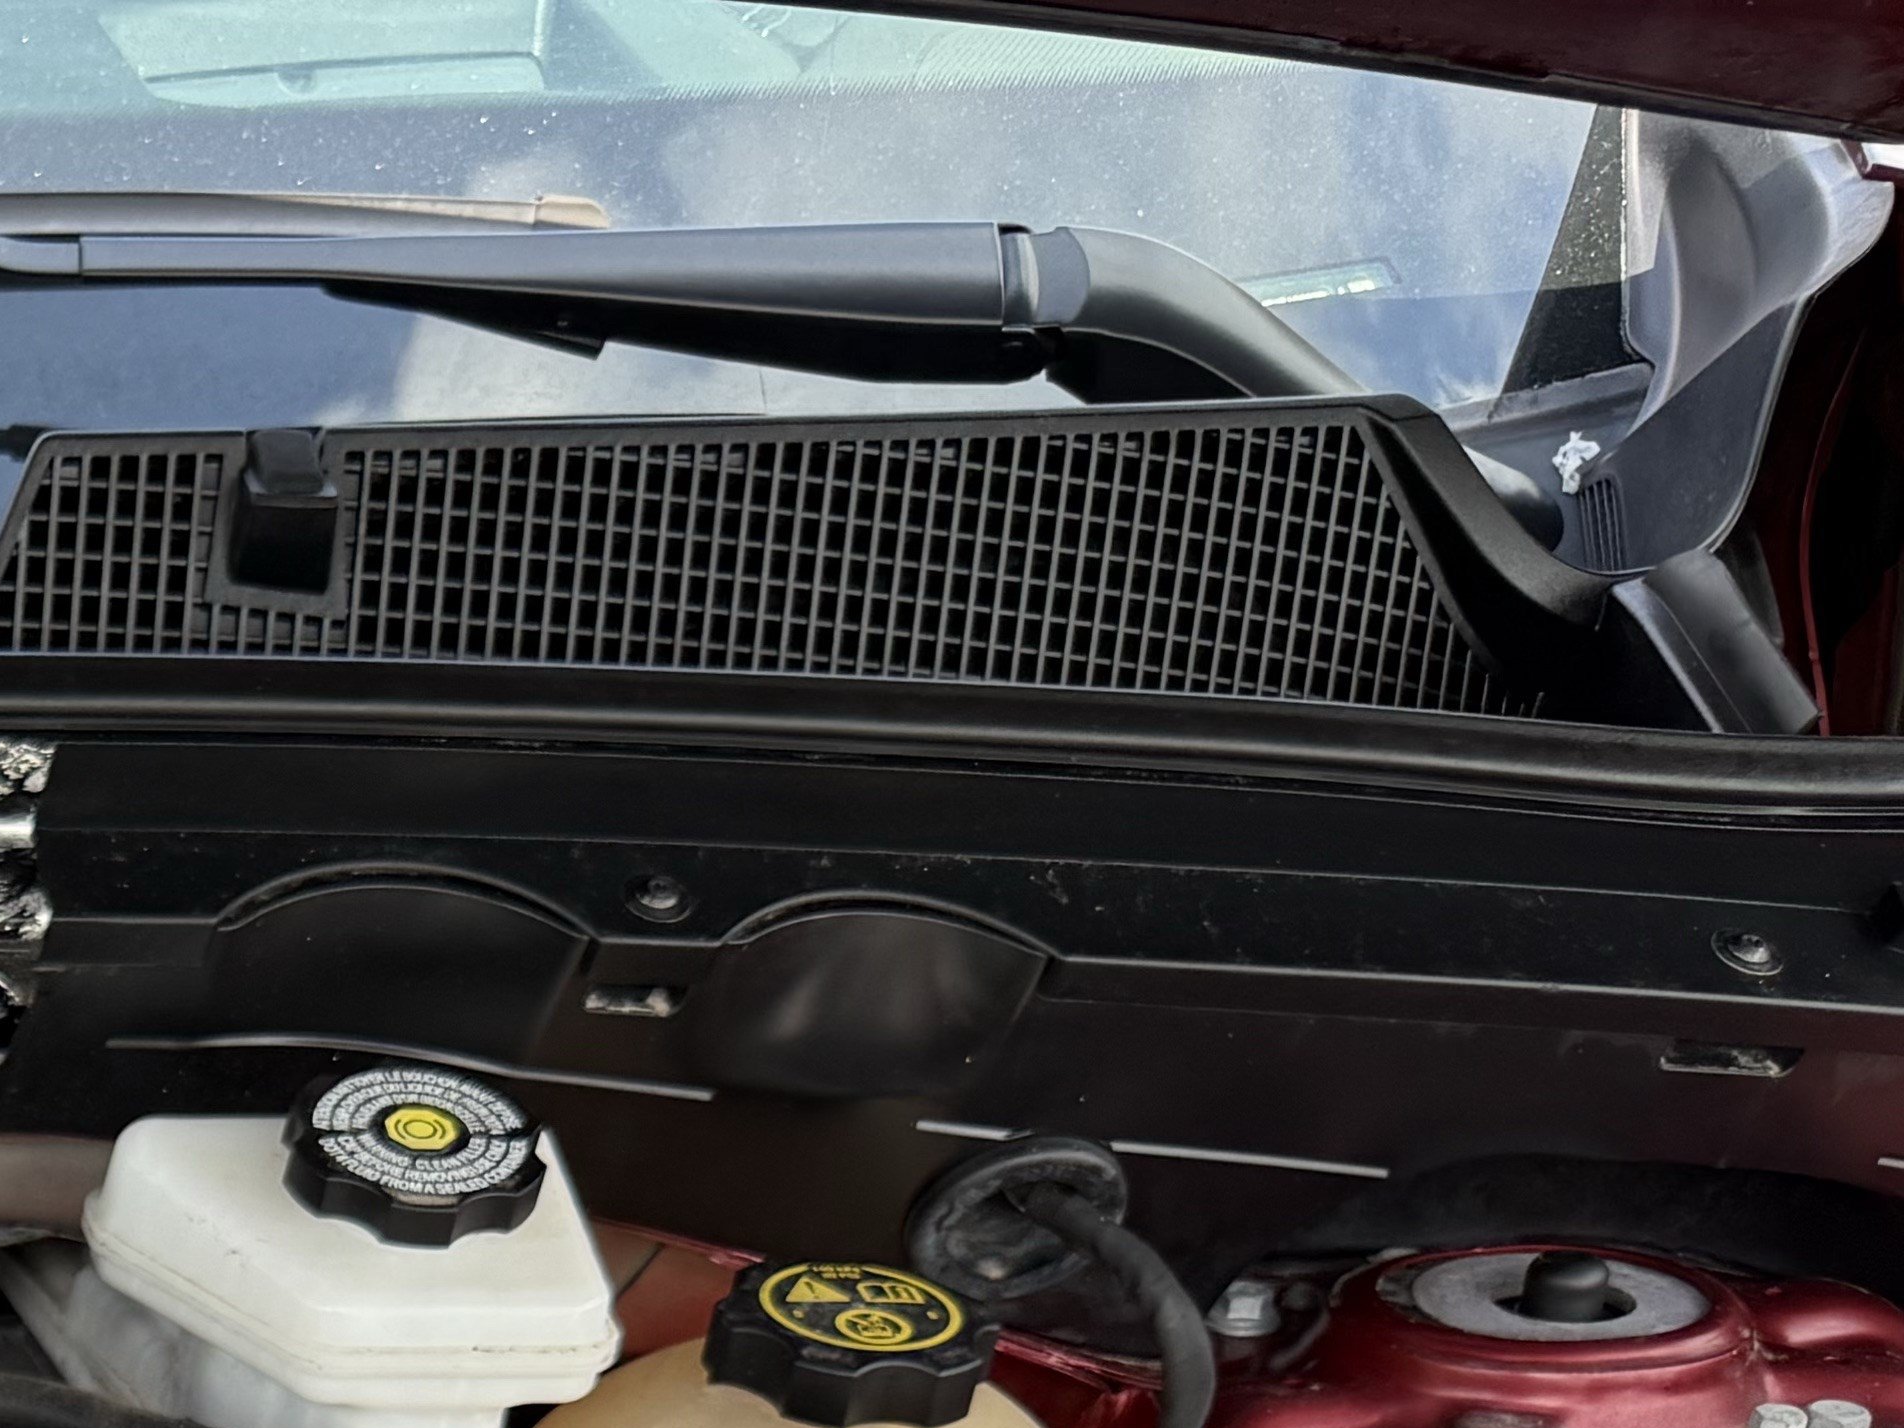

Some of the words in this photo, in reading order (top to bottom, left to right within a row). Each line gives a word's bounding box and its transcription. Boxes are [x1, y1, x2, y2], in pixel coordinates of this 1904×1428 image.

[338, 1156, 383, 1183] FLUID
[375, 1173, 423, 1193] FROM
[424, 1183, 435, 1194] A
[434, 1174, 491, 1196] SEALED
